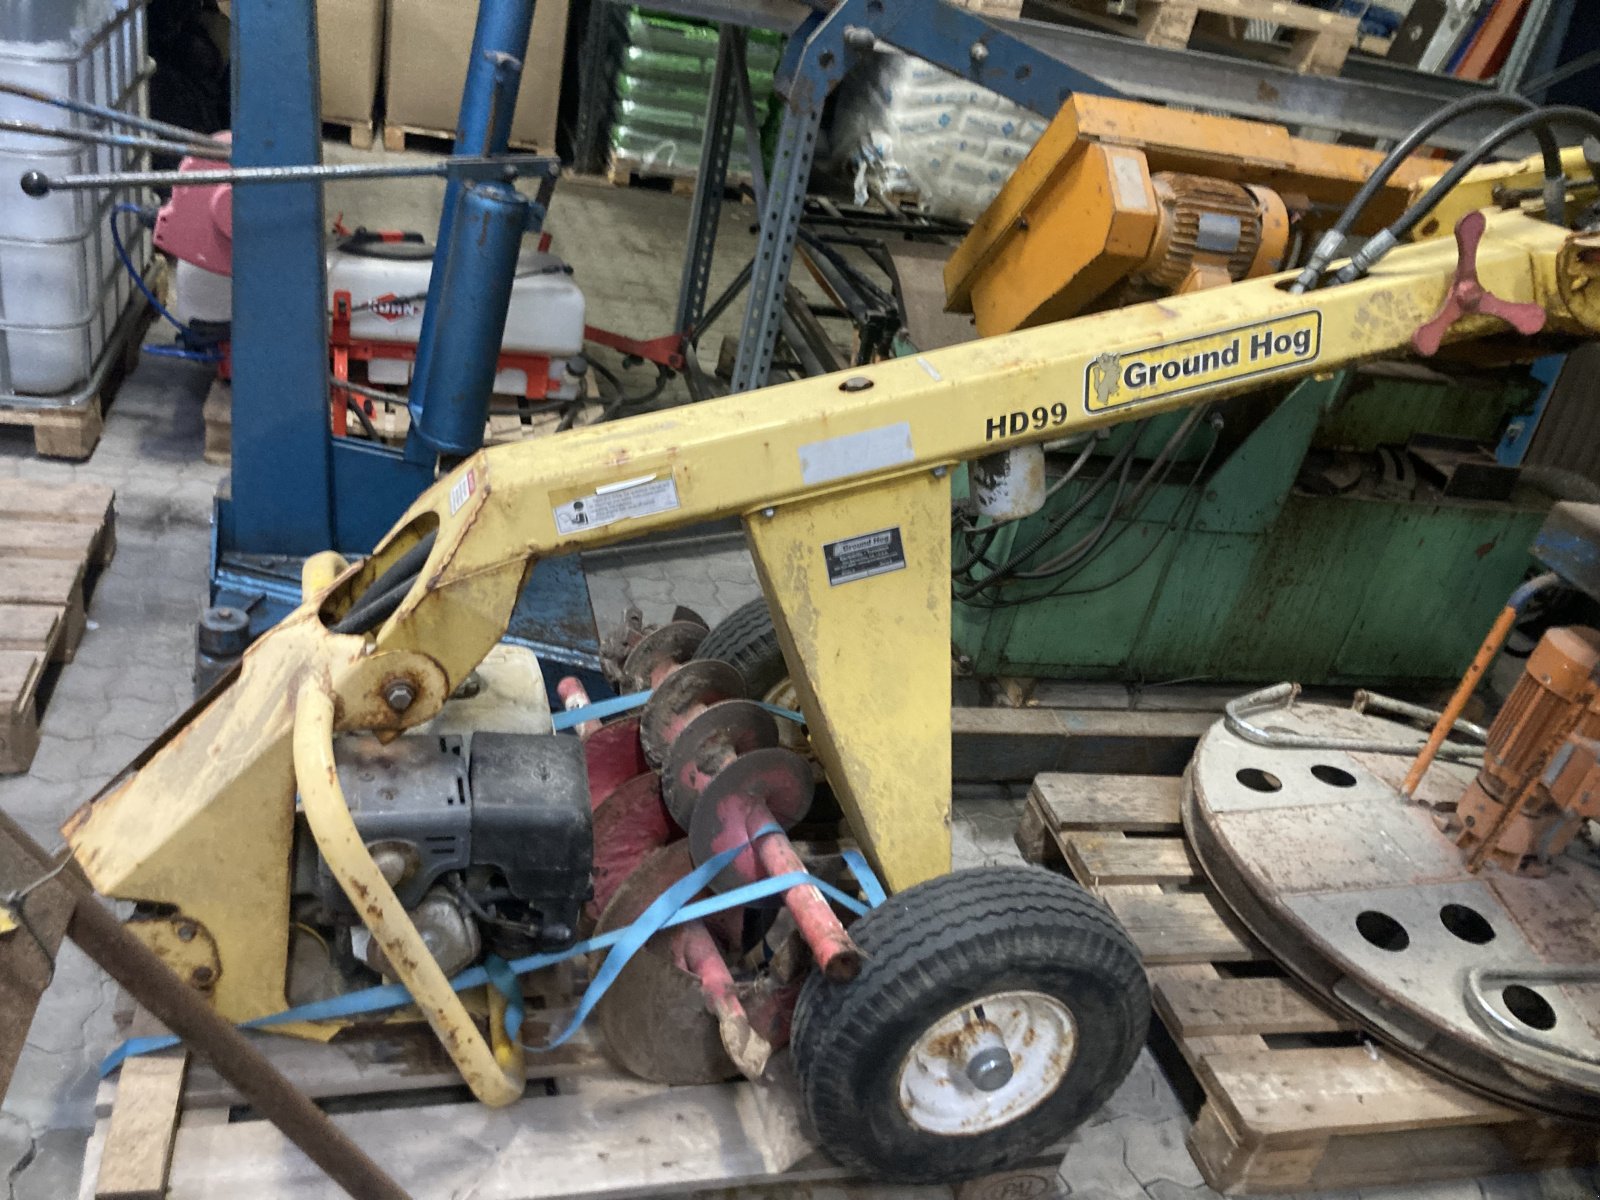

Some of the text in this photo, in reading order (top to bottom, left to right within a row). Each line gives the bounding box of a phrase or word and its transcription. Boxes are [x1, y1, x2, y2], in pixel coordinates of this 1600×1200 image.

[1124, 328, 1311, 388] Ground Hog
[985, 402, 1067, 442] HD99
